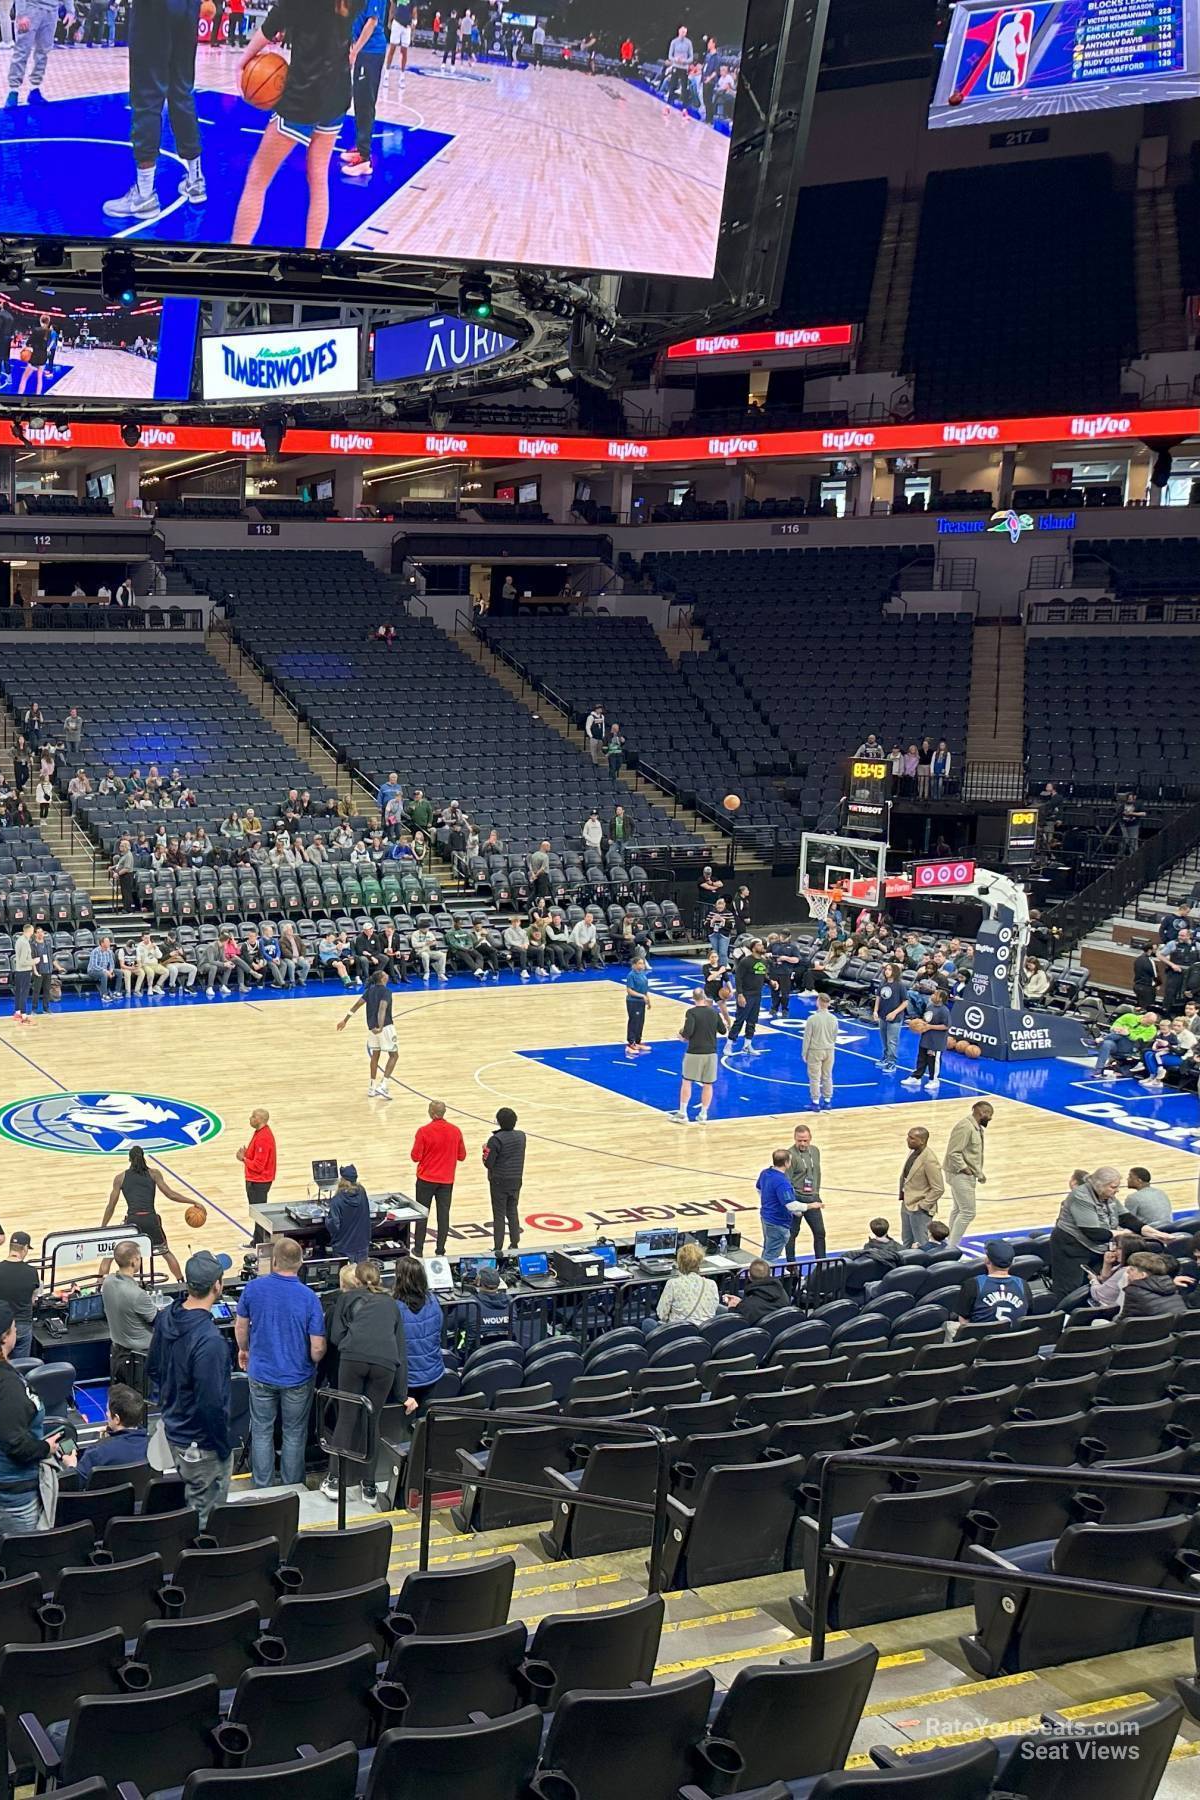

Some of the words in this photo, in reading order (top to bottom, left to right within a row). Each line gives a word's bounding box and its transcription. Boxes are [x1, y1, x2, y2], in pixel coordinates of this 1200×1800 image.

[1087, 16, 1109, 24] VICTOR
[1110, 10, 1152, 21] WEMBANYAMA
[1158, 7, 1172, 15] 223
[1128, 2, 1154, 11] SEASON
[1106, 19, 1146, 29] HOLMGREN
[1085, 33, 1110, 41] BROOK
[1111, 29, 1135, 38] LOPEZ
[1085, 40, 1119, 49] ANTHONY
[1121, 36, 1143, 45] DAVIS
[1083, 58, 1103, 67] RUDY
[1104, 54, 1133, 64] GOBERT
[1158, 49, 1172, 57] 143
[1084, 49, 1113, 58] WALKER
[1115, 44, 1146, 53] KESSLER
[992, 71, 1011, 85] NBA
[1082, 67, 1109, 76] DANIEL
[1110, 62, 1144, 72] GAFFORD
[1006, 131, 1033, 145] 217
[695, 336, 739, 354] HyVee
[774, 329, 820, 347] HyVee
[221, 339, 337, 389] TIMBERWOLVES
[943, 424, 999, 445] HyVee
[1071, 416, 1131, 438] HyVee
[139, 427, 175, 447] yVee
[231, 430, 266, 450] HyV
[330, 433, 373, 452] HyVee
[425, 436, 468, 455] HyVee
[822, 431, 874, 451] HyVee
[518, 439, 559, 458] HyVee
[608, 442, 648, 460] HyVee
[708, 437, 758, 457] HyVee
[255, 524, 273, 534] 113
[781, 524, 800, 534] 116
[937, 517, 985, 534] Treasure
[33, 536, 51, 545] 112
[859, 806, 883, 815] TISSOT
[948, 1026, 998, 1046] CFMOTO
[1009, 1028, 1050, 1041] TARGET
[1011, 1038, 1052, 1051] CENTER
[586, 1198, 759, 1227] TARGET
[982, 1290, 1024, 1309] EDWARDS
[482, 1315, 509, 1325] WOLVE
[995, 1306, 1012, 1325] 5
